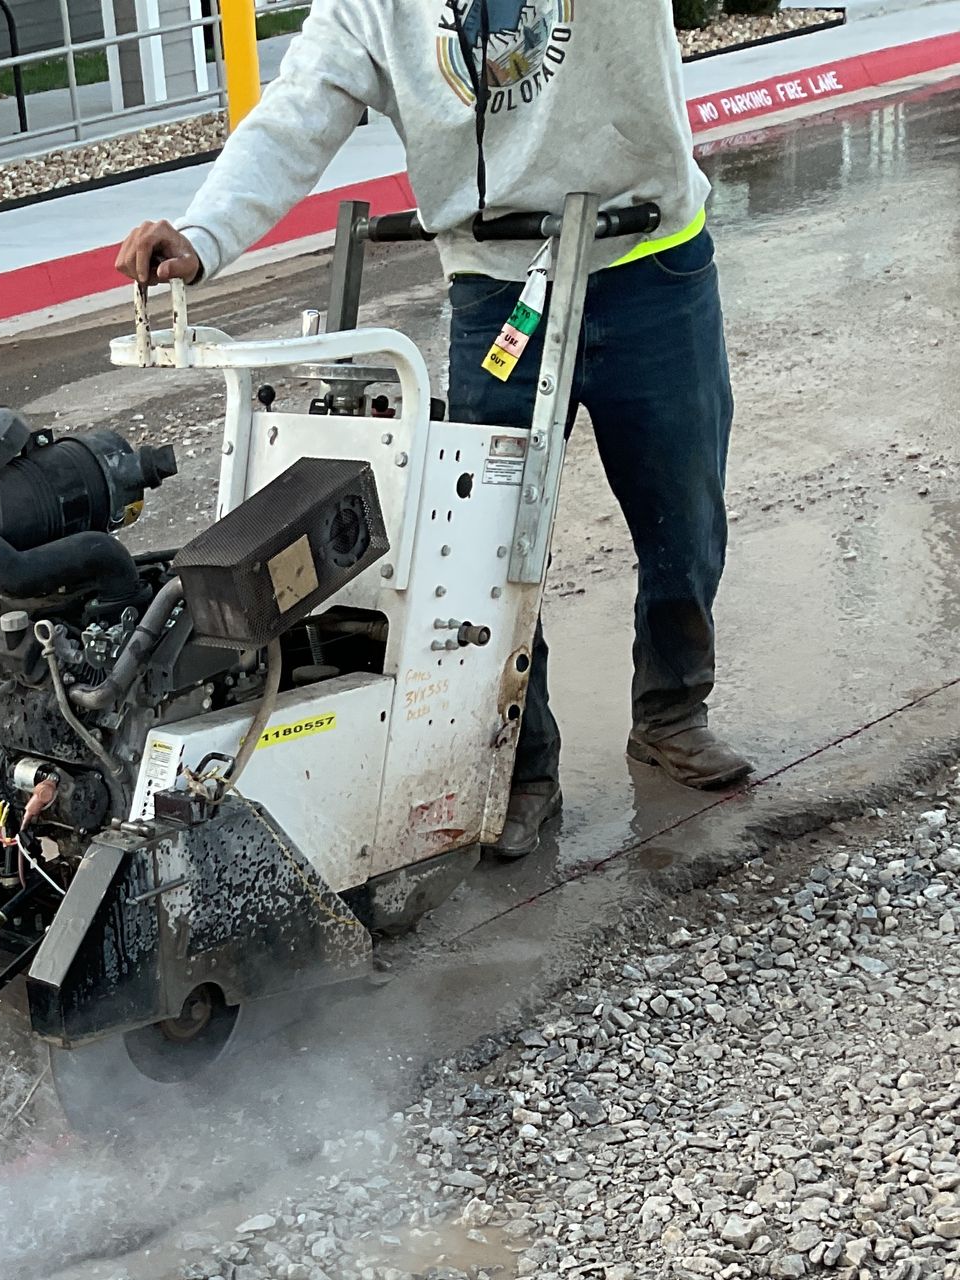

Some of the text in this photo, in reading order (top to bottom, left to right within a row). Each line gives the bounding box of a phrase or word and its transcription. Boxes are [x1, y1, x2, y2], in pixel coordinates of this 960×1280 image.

[485, 27, 572, 115] OLORADO
[697, 71, 843, 122] NO PARKING FIRE LANE
[504, 334, 518, 346] USE
[490, 353, 505, 367] OUT
[261, 716, 335, 741] 1180557
